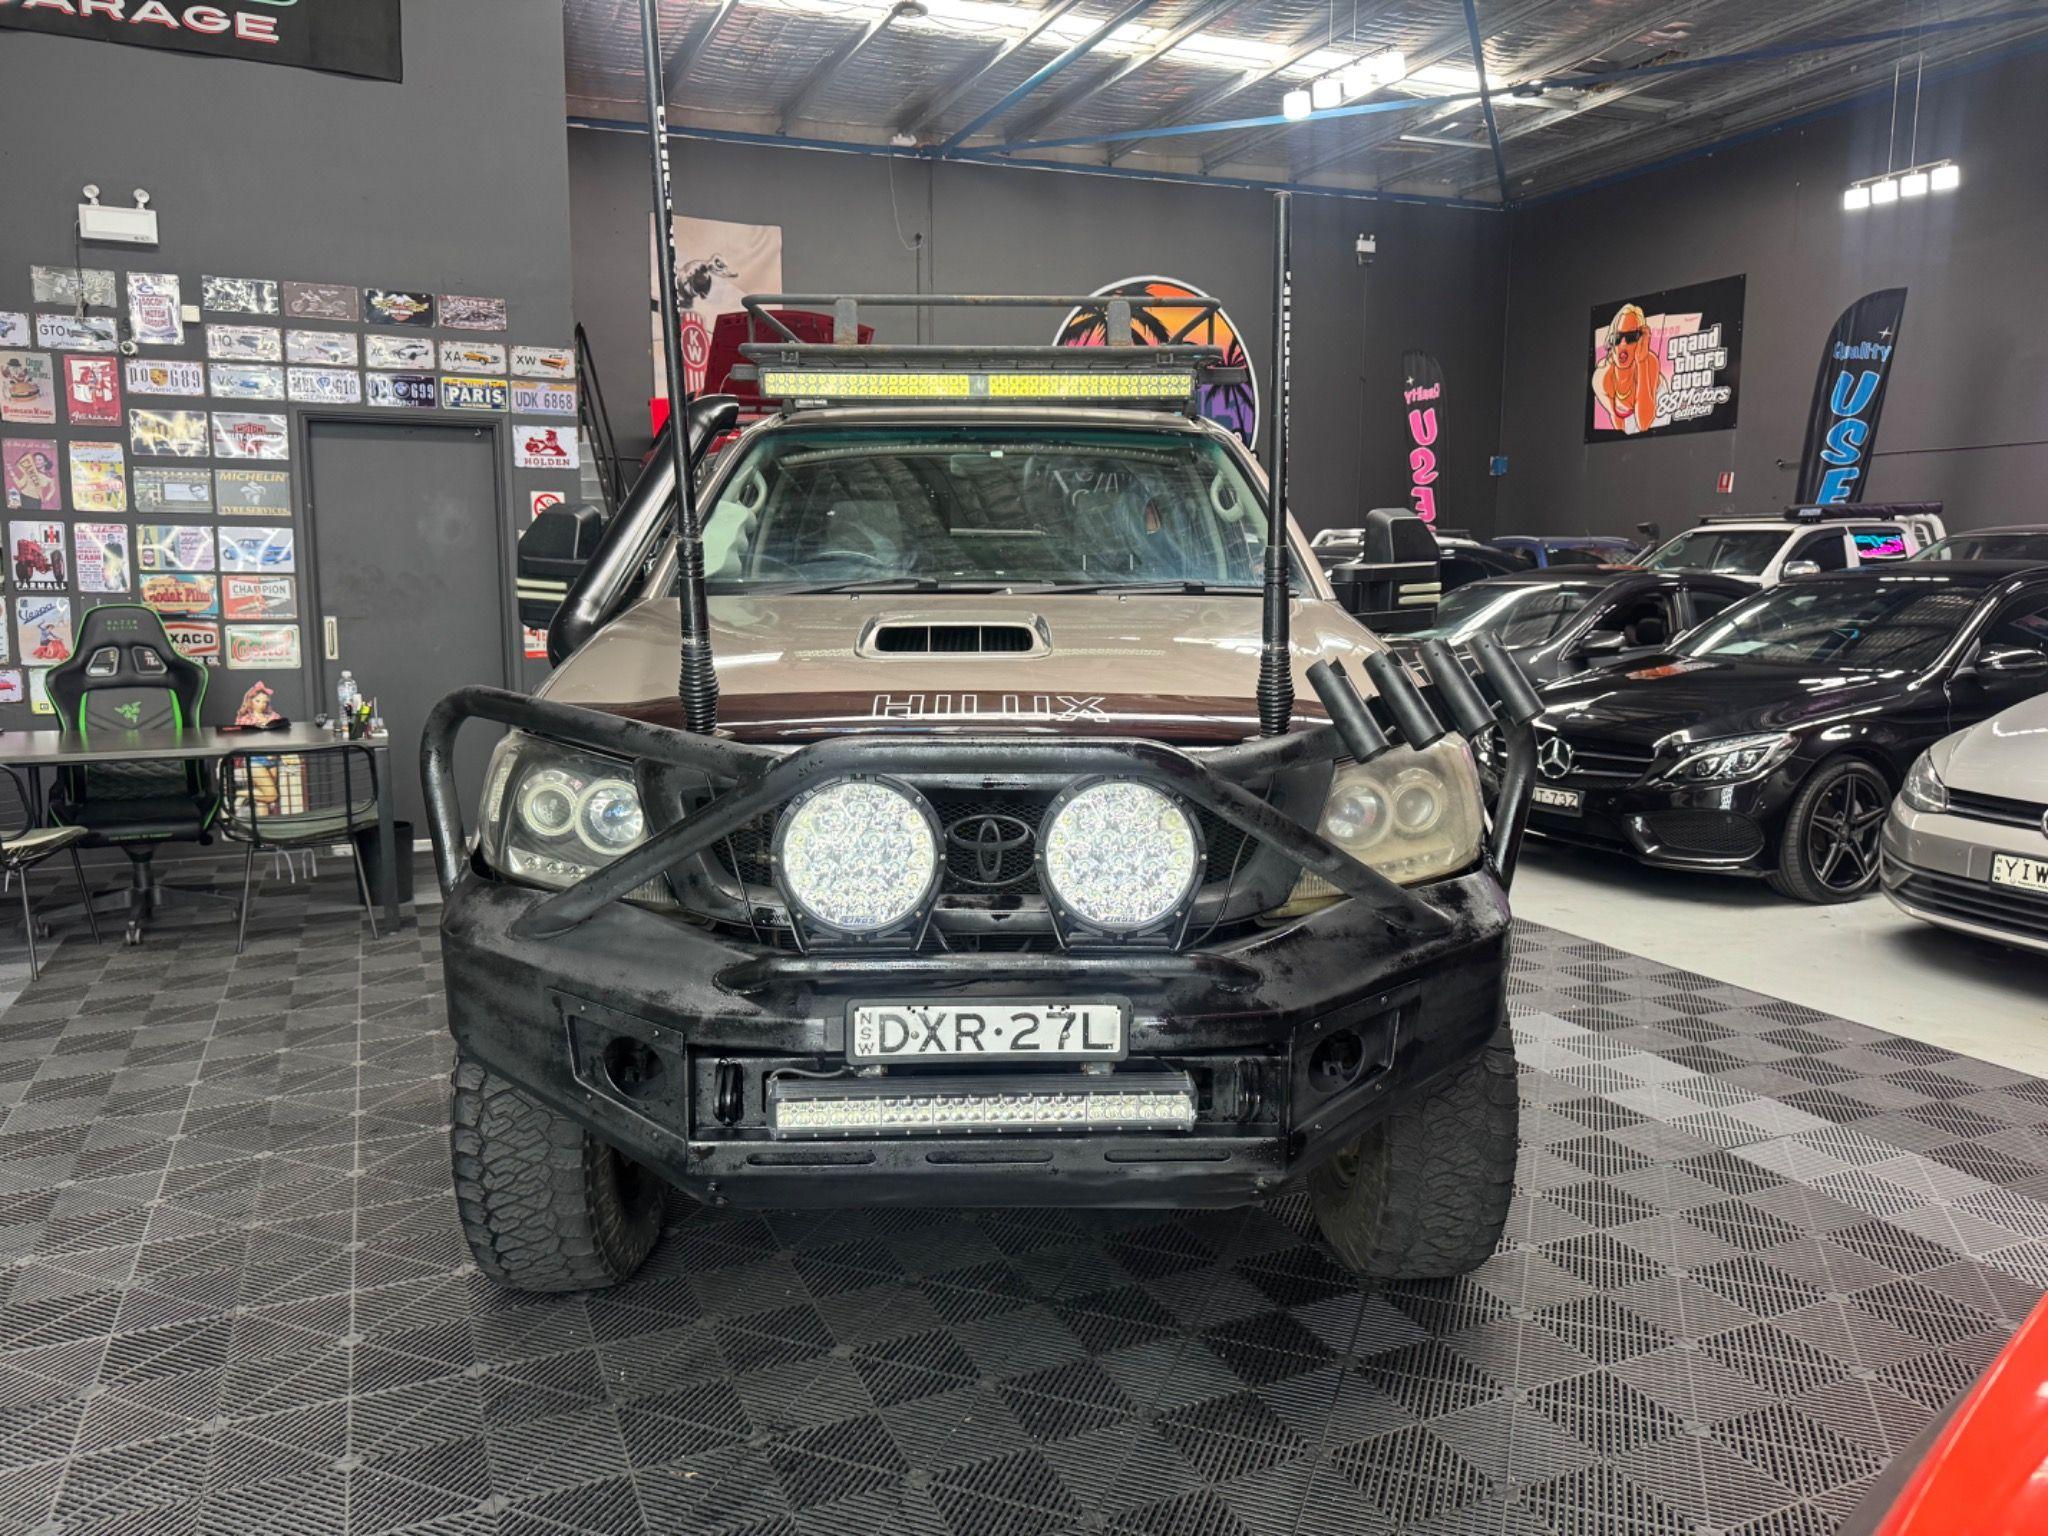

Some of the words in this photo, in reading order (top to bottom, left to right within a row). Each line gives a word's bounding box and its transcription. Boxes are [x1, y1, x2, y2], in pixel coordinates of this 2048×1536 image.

[1, 0, 280, 43] ARAGE
[40, 323, 66, 337] GTO
[516, 354, 536, 365] XW
[1833, 340, 1893, 363] Quality
[1672, 369, 1712, 390] auto
[448, 387, 503, 404] PARIS
[515, 391, 538, 409] UDK
[544, 393, 573, 411] 6868
[524, 457, 570, 466] HOLDEN
[219, 472, 286, 482] MICHELIN
[16, 582, 67, 591] FARMALL
[170, 633, 214, 645] XACO
[233, 631, 292, 662] Castrol
[872, 694, 1110, 722] HILUX
[858, 1012, 874, 1055] NSW
